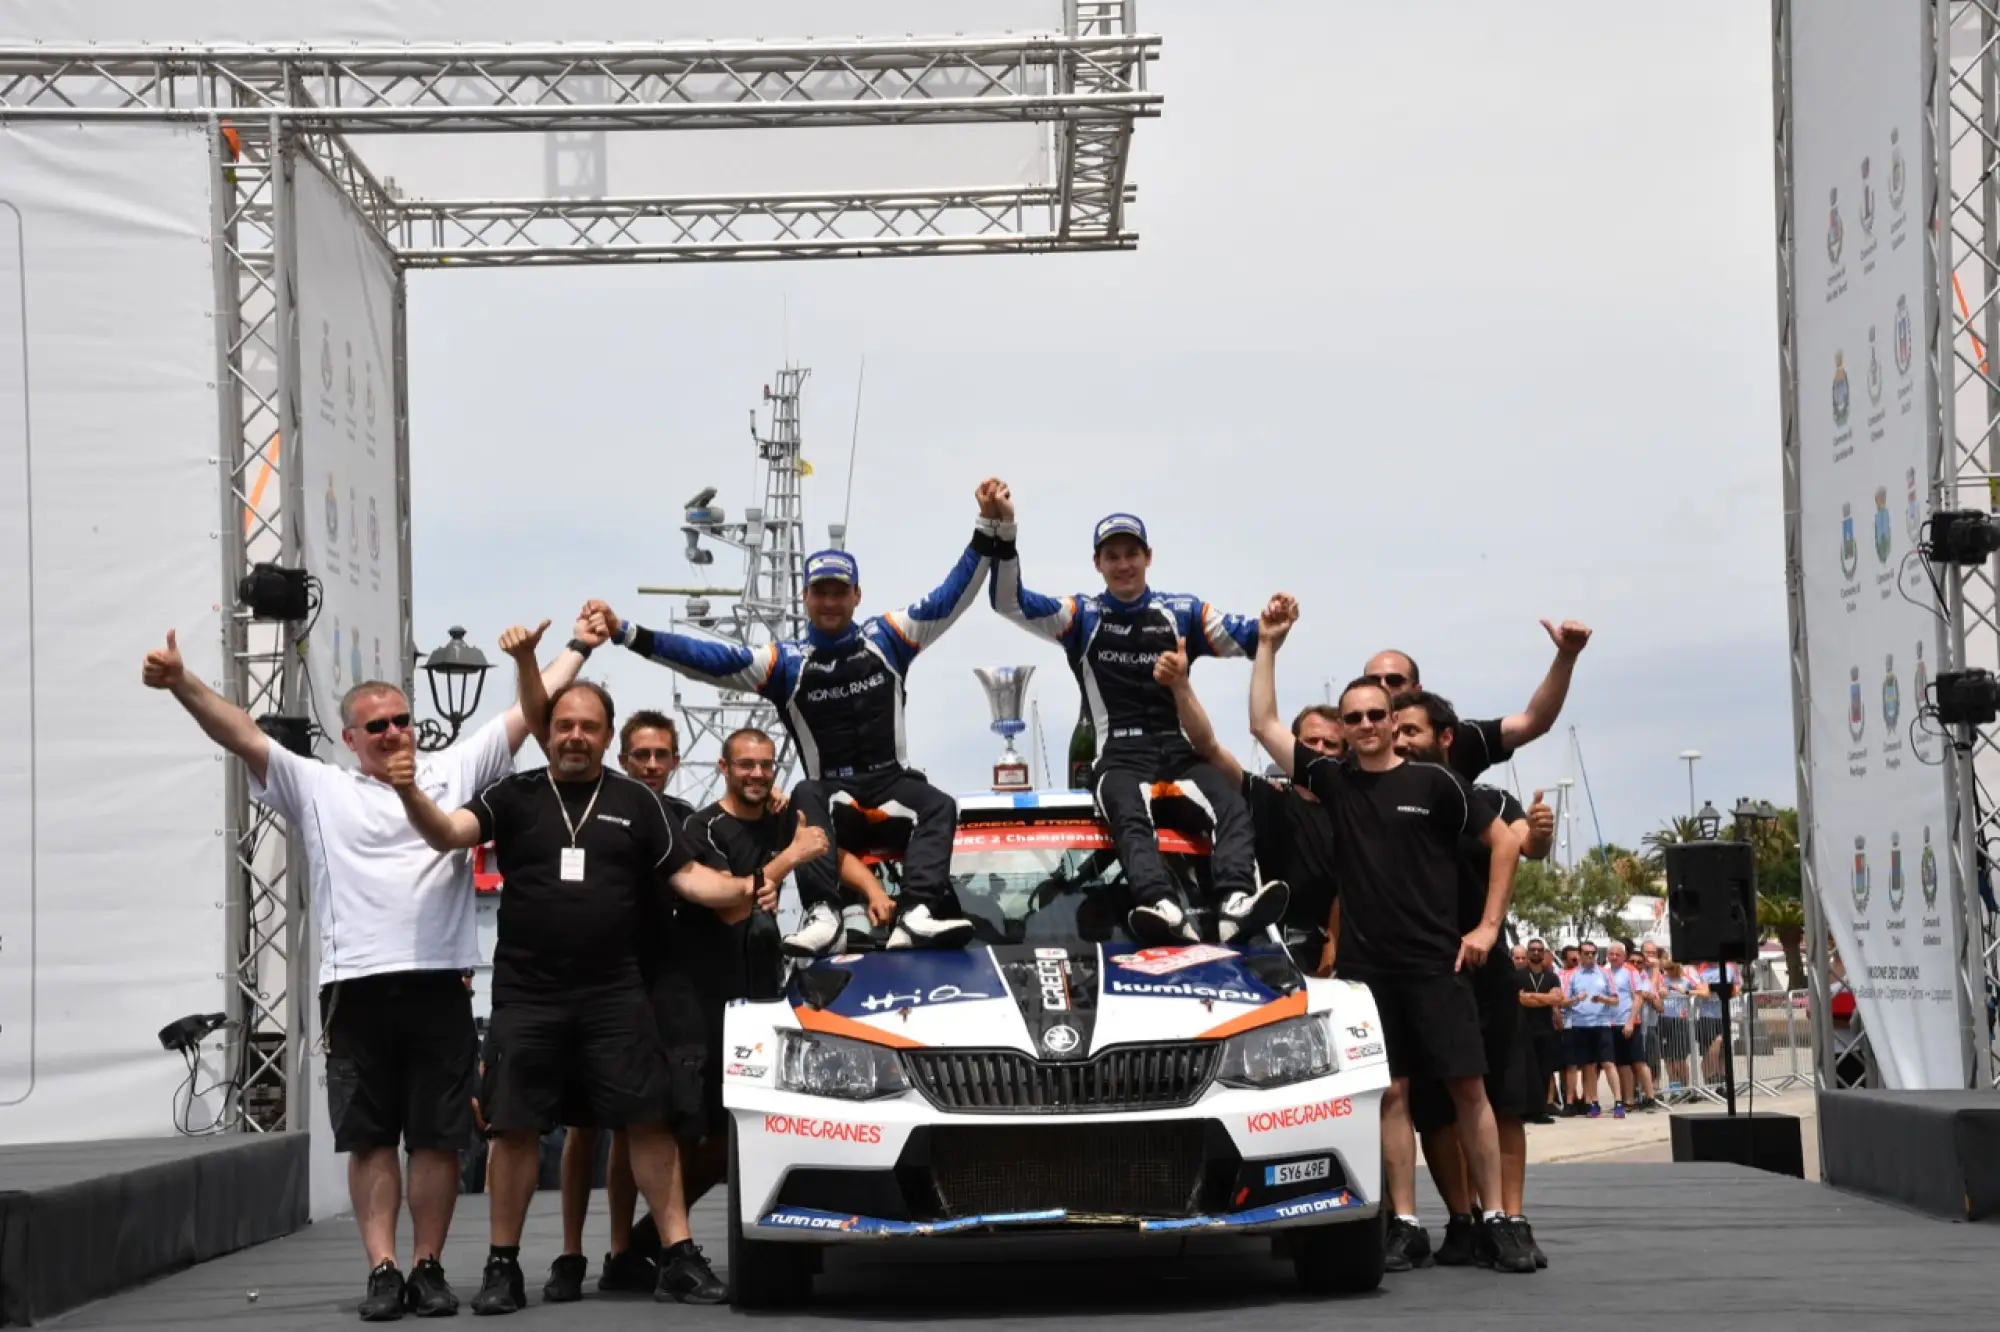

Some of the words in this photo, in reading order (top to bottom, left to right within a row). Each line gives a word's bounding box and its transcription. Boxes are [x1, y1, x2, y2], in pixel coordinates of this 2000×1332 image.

[807, 672, 885, 702] KONECRANES
[764, 1114, 881, 1144] KONECRANES
[1247, 1098, 1354, 1133] KONECRANES
